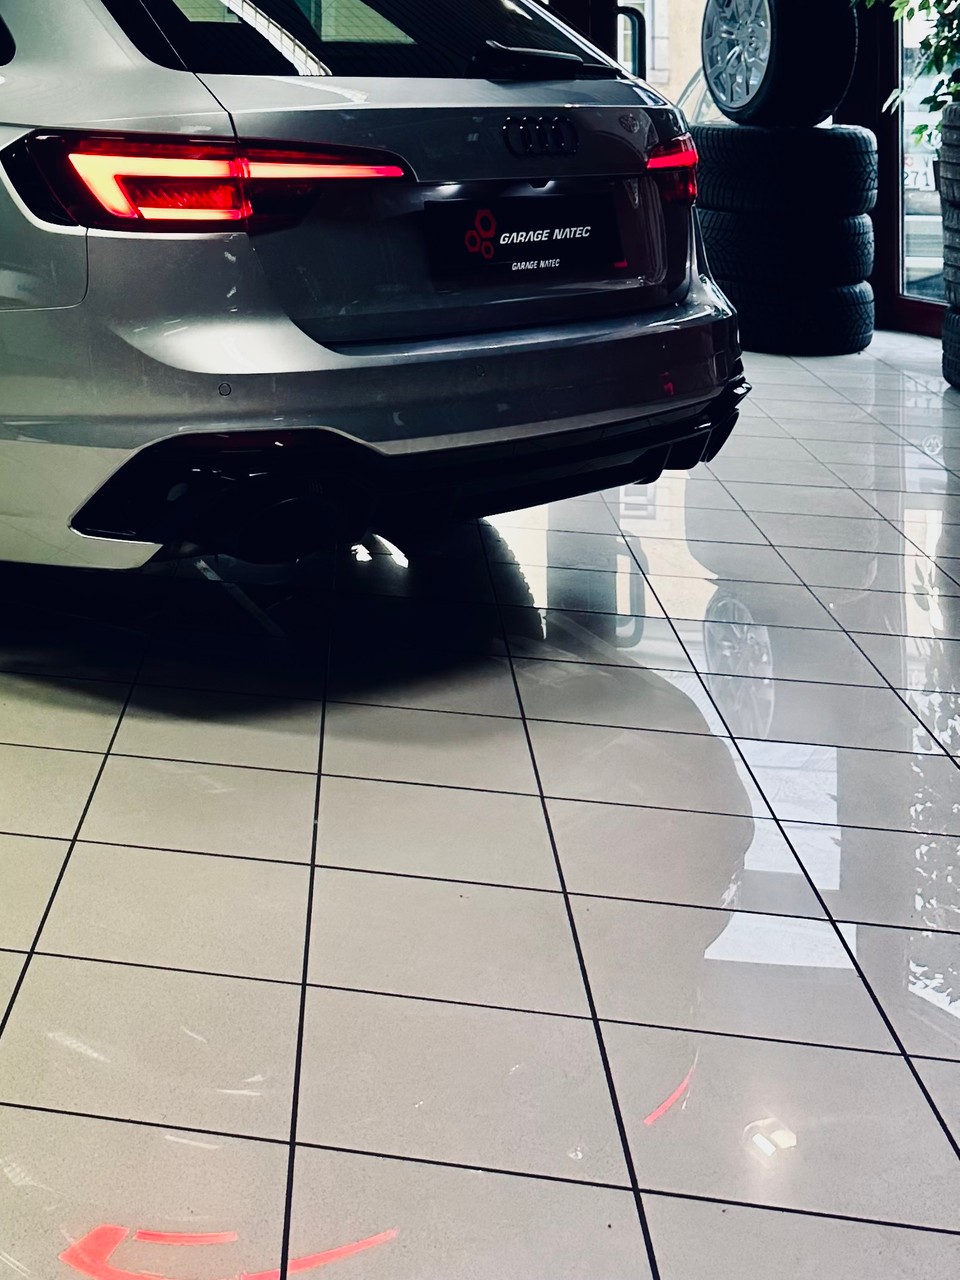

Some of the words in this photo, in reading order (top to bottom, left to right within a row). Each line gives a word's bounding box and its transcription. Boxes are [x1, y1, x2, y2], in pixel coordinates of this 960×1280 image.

[499, 229, 551, 245] GARAGE
[552, 226, 592, 240] NATEC
[511, 260, 538, 271] GARAGE
[539, 258, 560, 269] NATEC
